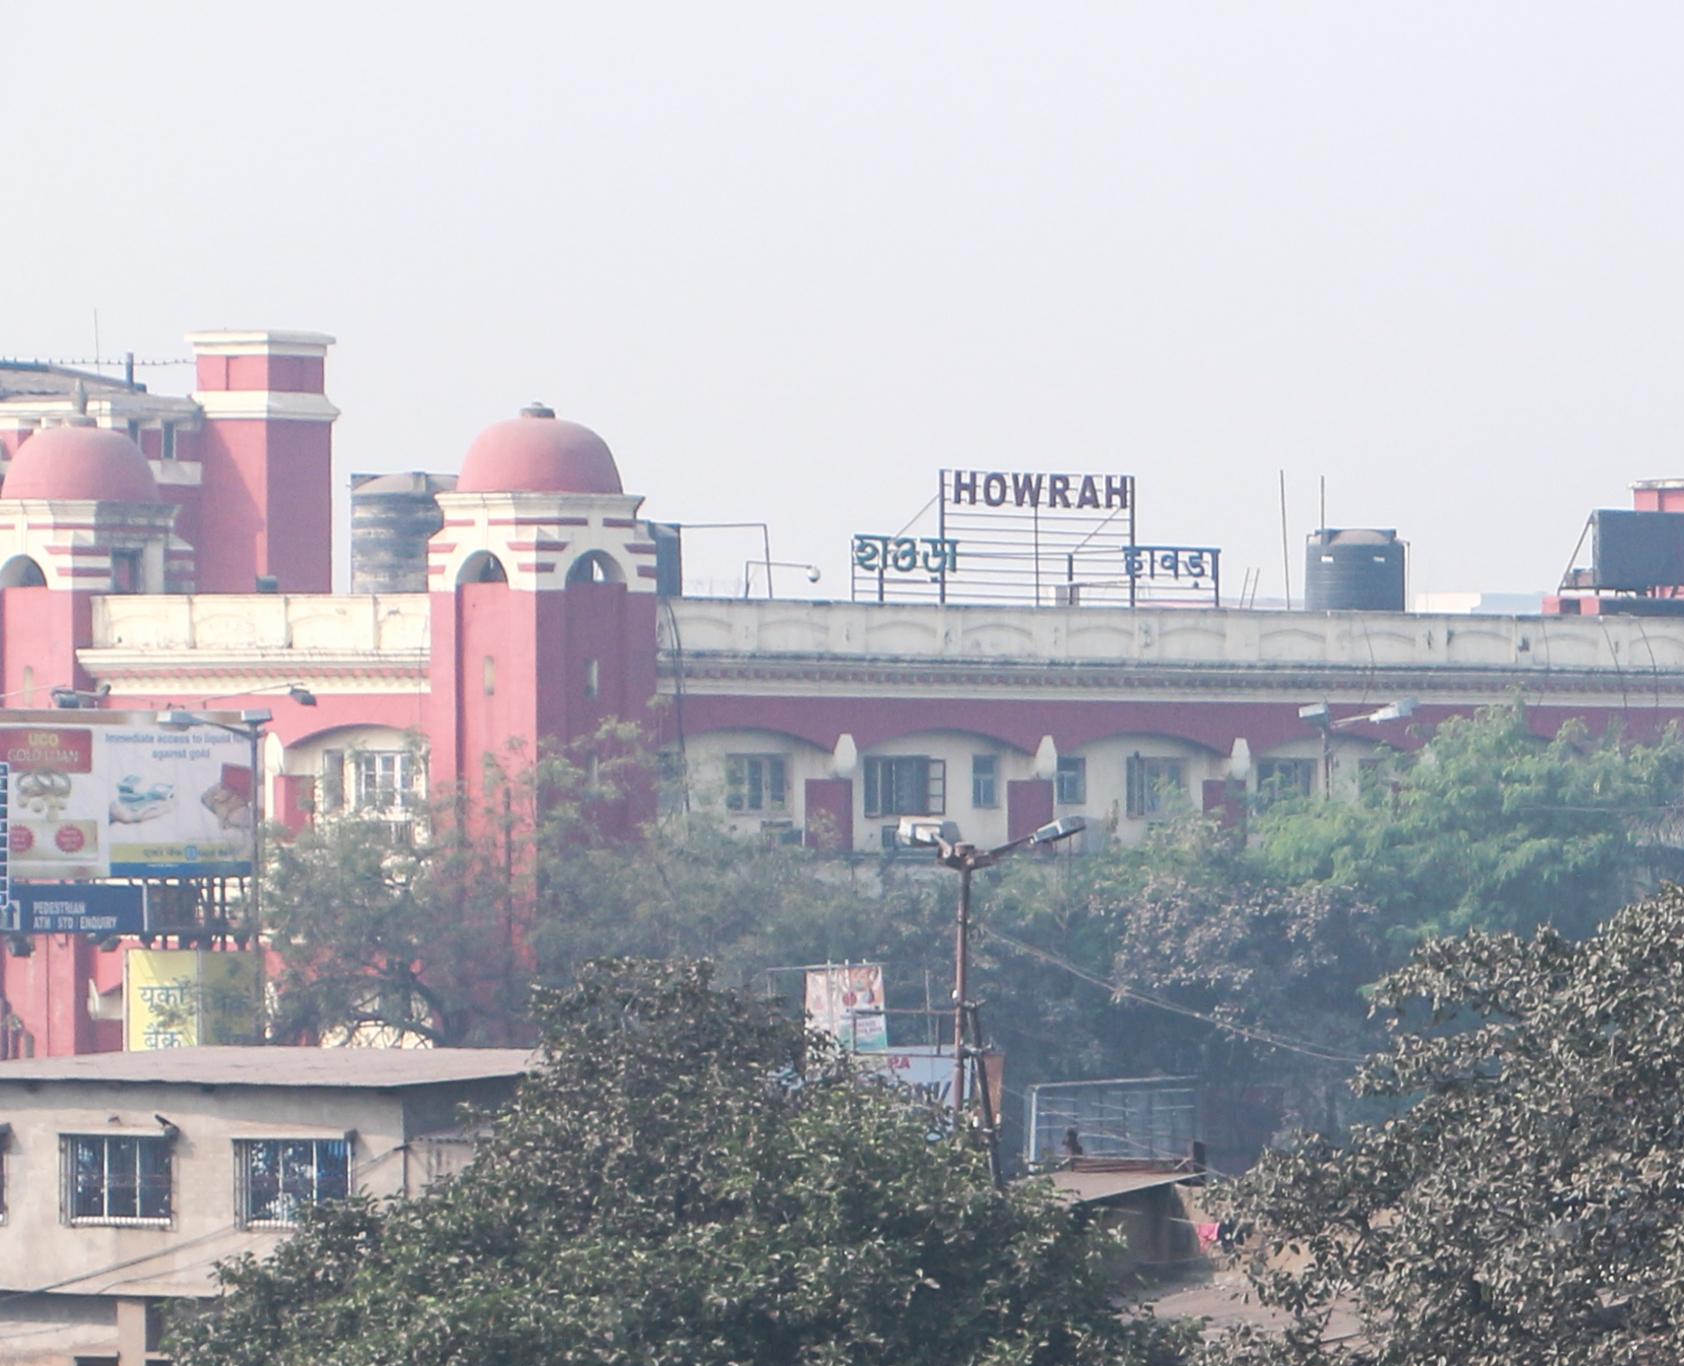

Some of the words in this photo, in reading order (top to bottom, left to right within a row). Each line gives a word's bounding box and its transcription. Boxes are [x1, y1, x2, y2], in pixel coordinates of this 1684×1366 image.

[952, 470, 1129, 510] HOWRAH
[853, 533, 961, 584] হাওড়া
[1122, 546, 1221, 589] हावड़ा
[33, 902, 86, 914] PEDESTRIAN
[33, 916, 51, 929] ATM
